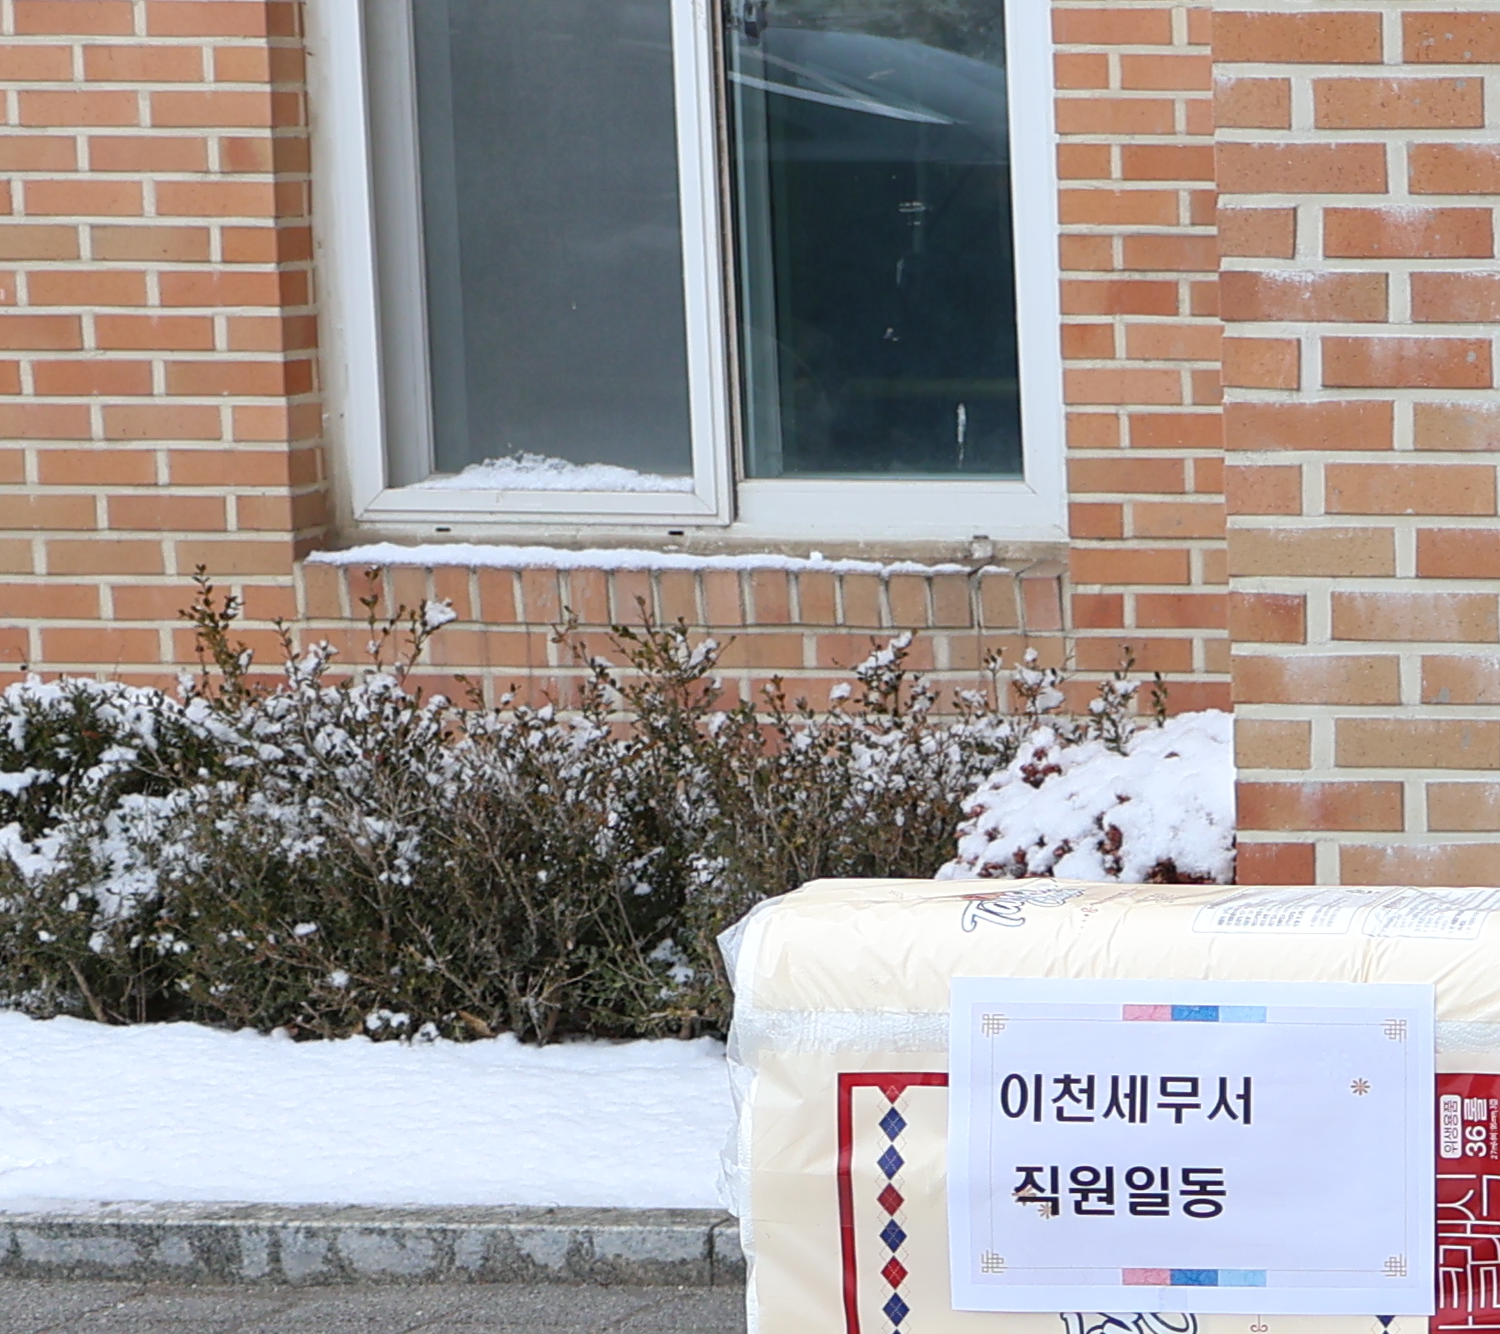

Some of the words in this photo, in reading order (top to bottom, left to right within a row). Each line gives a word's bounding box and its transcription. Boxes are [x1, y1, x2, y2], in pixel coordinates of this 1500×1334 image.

[1000, 1074, 1255, 1127] 이천세무서
[1441, 1100, 1459, 1153] 위생용품
[1014, 1165, 1228, 1221] 직원일동
